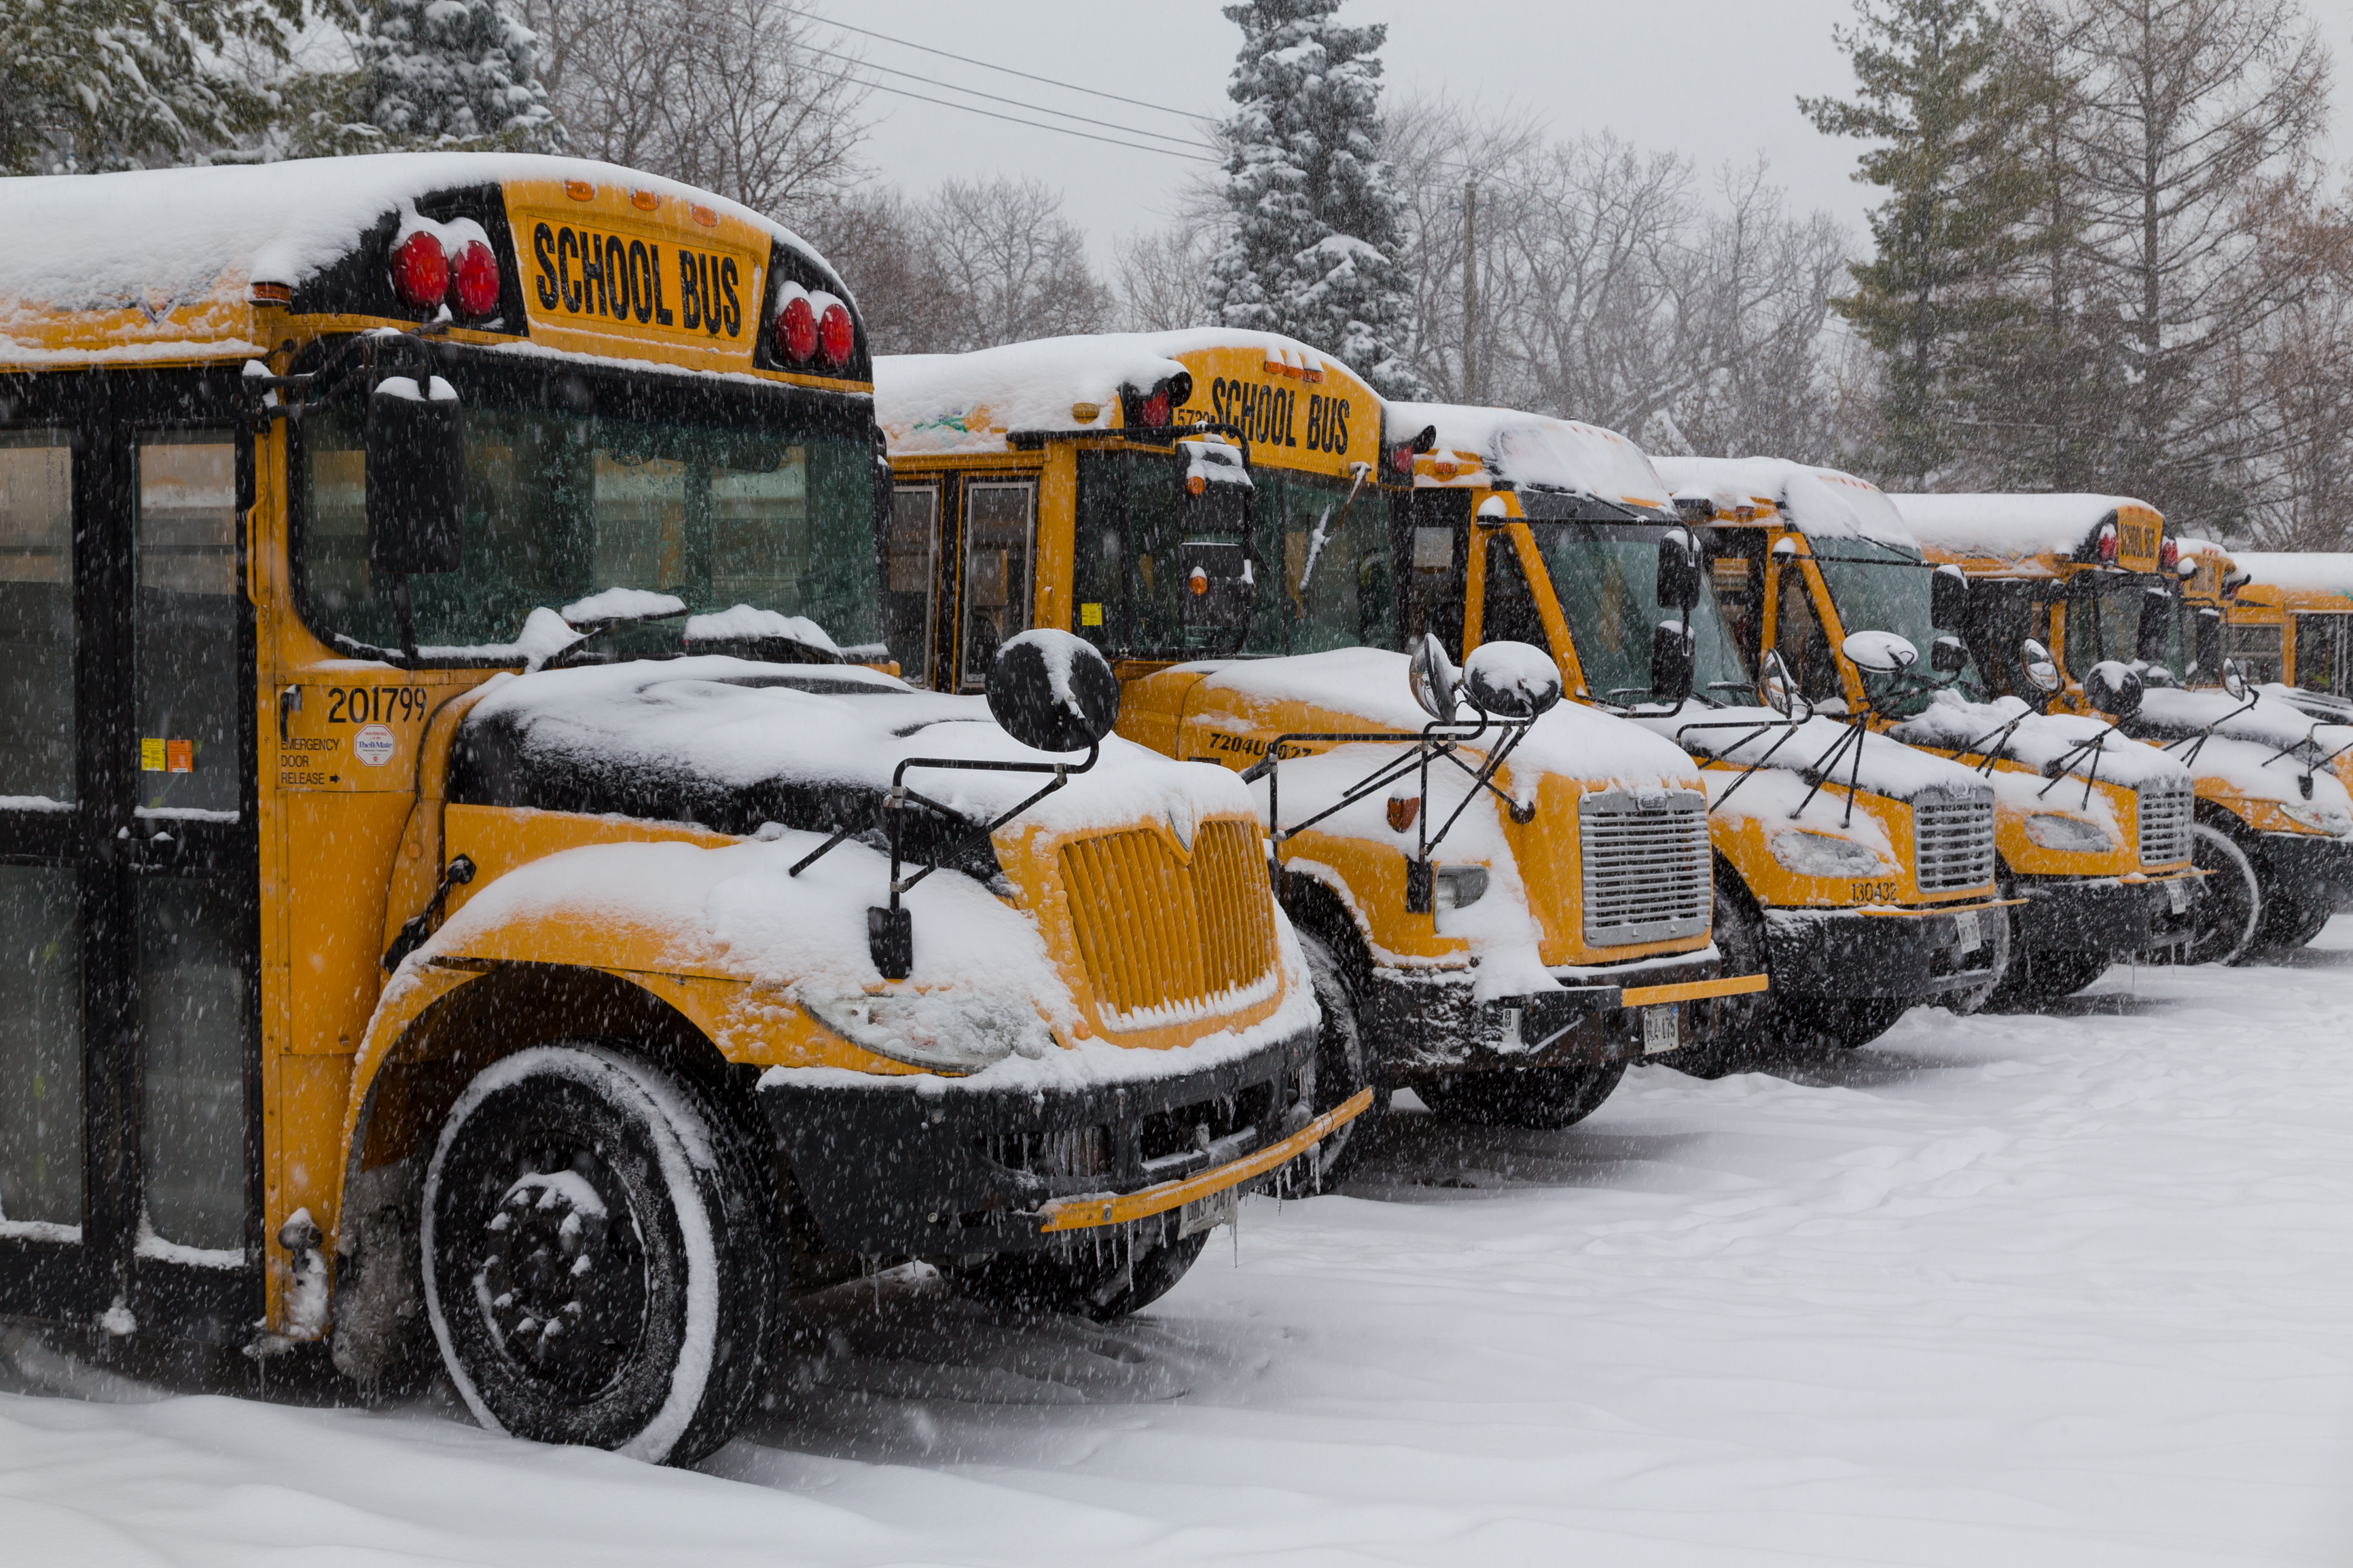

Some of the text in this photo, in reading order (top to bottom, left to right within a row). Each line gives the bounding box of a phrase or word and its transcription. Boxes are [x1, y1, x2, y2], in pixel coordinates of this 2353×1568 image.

[534, 222, 741, 338] SCHOOL BUS
[1212, 377, 1350, 455] SCHOOL BUS
[2121, 523, 2143, 558] SCHOOL
[328, 687, 427, 723] 201799
[281, 738, 340, 750] EMERGENCY
[281, 755, 309, 767] DOOR
[281, 772, 325, 784] RELEASE
[1852, 882, 1897, 902] 130432
